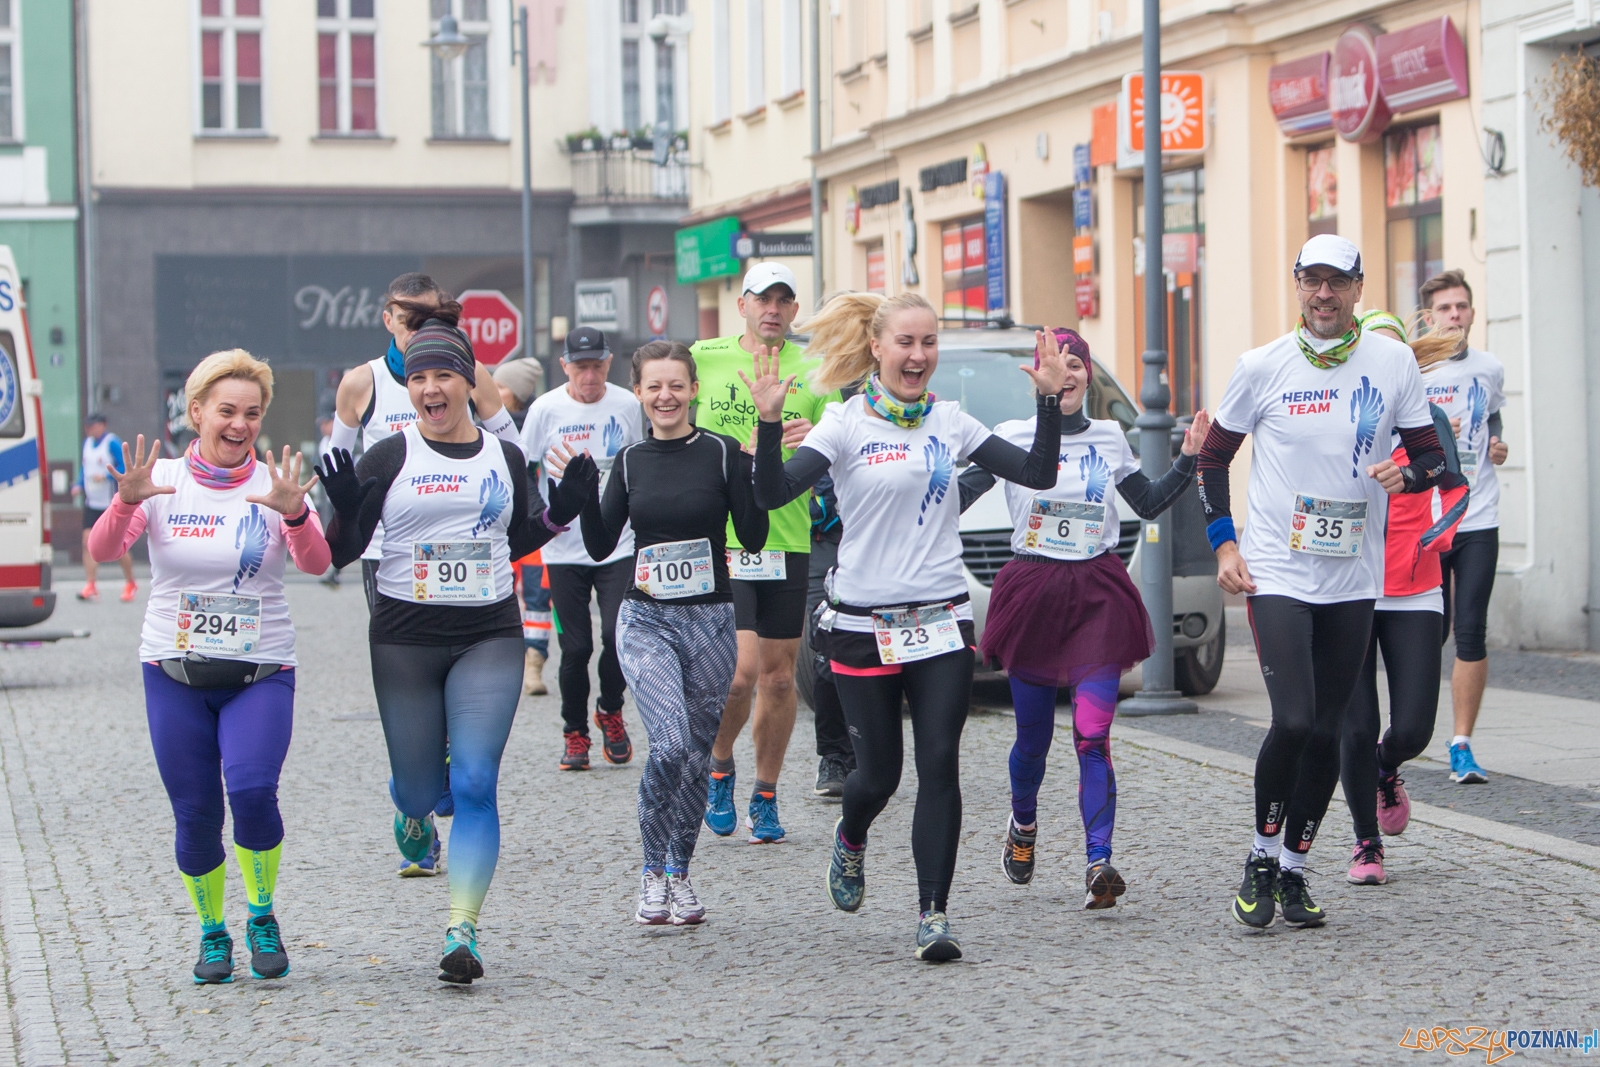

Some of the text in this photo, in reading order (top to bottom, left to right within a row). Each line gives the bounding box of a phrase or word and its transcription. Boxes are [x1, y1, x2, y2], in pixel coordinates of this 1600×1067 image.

[759, 240, 812, 254] bankoma
[1282, 388, 1340, 404] HERNIK
[1425, 384, 1460, 396] ERNIK
[1288, 402, 1331, 416] TEAM
[385, 411, 421, 423] HERNI
[558, 423, 596, 434] HERNIK
[562, 432, 590, 442] TEAM
[860, 443, 911, 456] HERNIK
[867, 452, 907, 465] TEAM
[411, 474, 469, 486] HERNIK
[416, 484, 459, 495] TEAM
[167, 514, 226, 525] HERNIK
[171, 527, 215, 538] TEAM
[1058, 519, 1070, 538] 6
[1314, 517, 1343, 539] 35
[1045, 537, 1076, 547] Magdalena
[1312, 539, 1341, 547] Krzysztof
[740, 549, 762, 566] 83
[438, 562, 467, 583] 90
[653, 561, 692, 582] 100
[193, 613, 238, 636] 294
[205, 637, 223, 645] Edyta
[900, 627, 929, 647] 23
